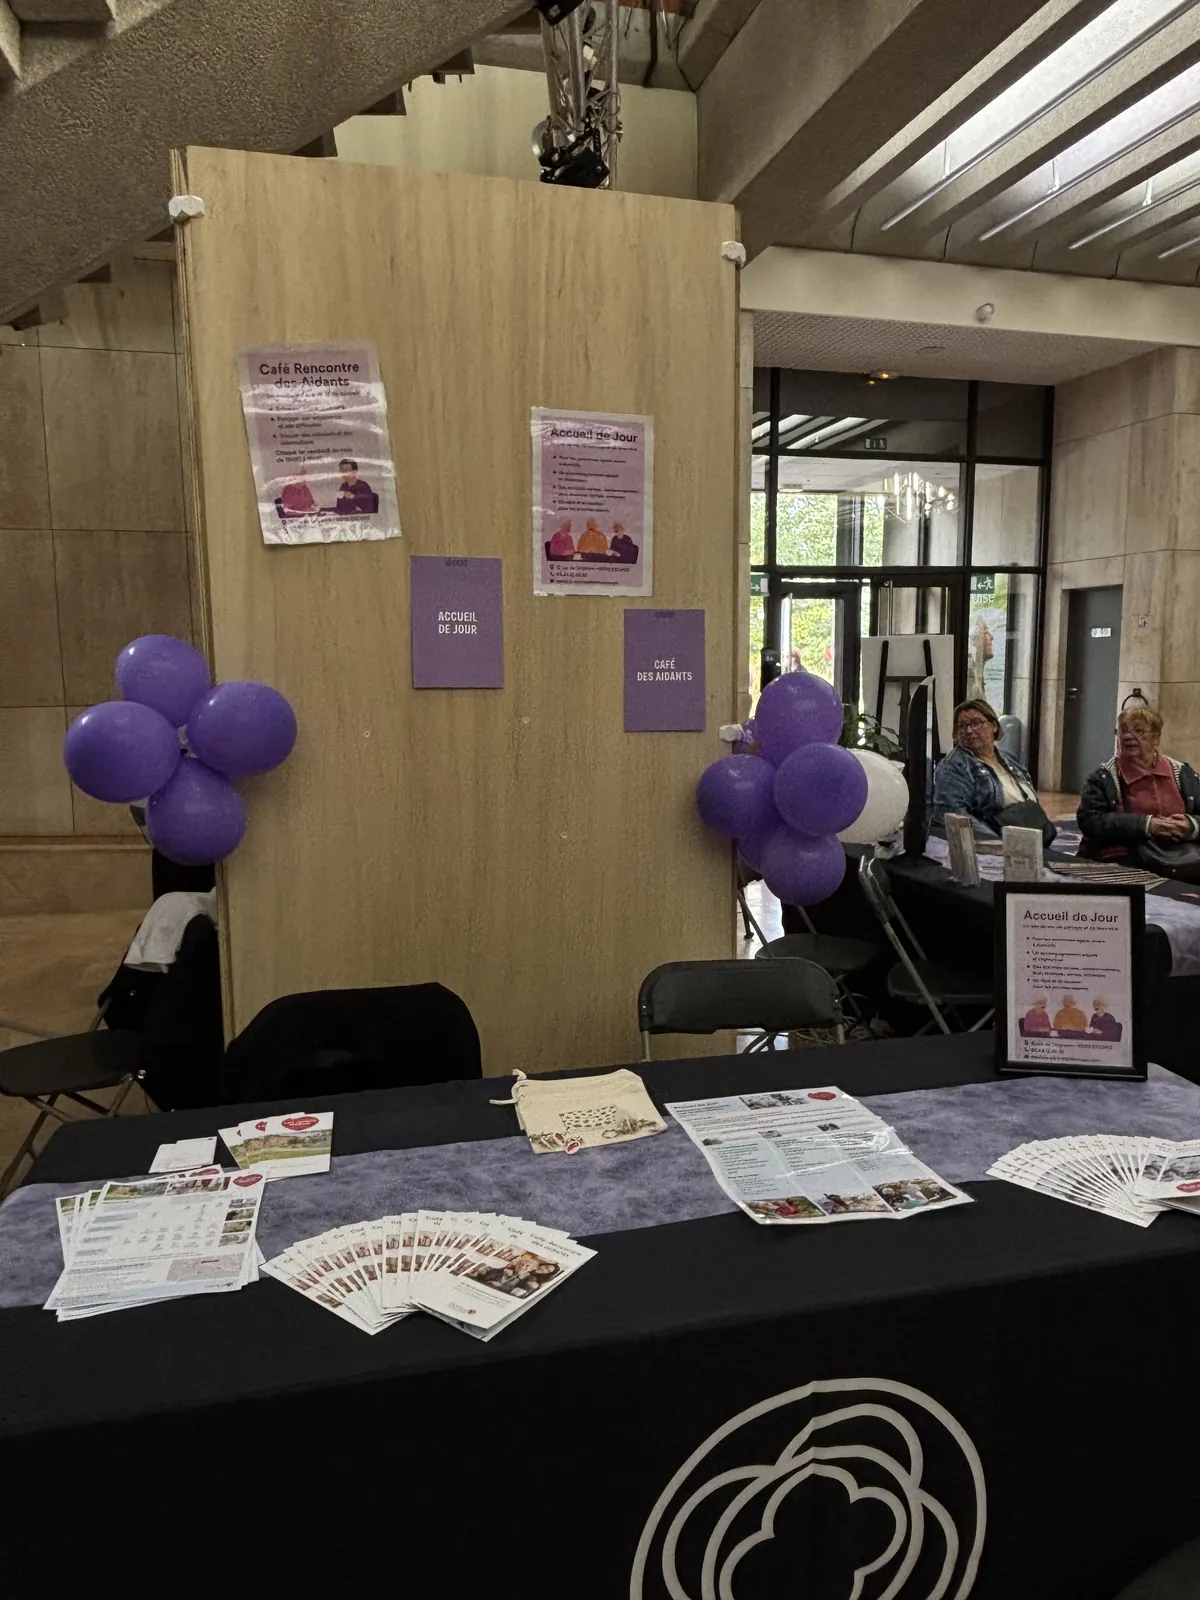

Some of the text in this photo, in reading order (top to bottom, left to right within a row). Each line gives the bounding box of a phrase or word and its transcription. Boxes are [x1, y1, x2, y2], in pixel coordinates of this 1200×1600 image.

[260, 362, 360, 376] Café Rencontre
[301, 375, 350, 388] Aidants
[550, 427, 638, 443] Accueil de Jour
[438, 611, 478, 622] ACCUEIL
[438, 624, 477, 635] DE JOUR
[654, 657, 676, 670] CAFÉ
[637, 671, 693, 681] DES AIDANTS
[1023, 910, 1119, 923] Accueil de Jour
